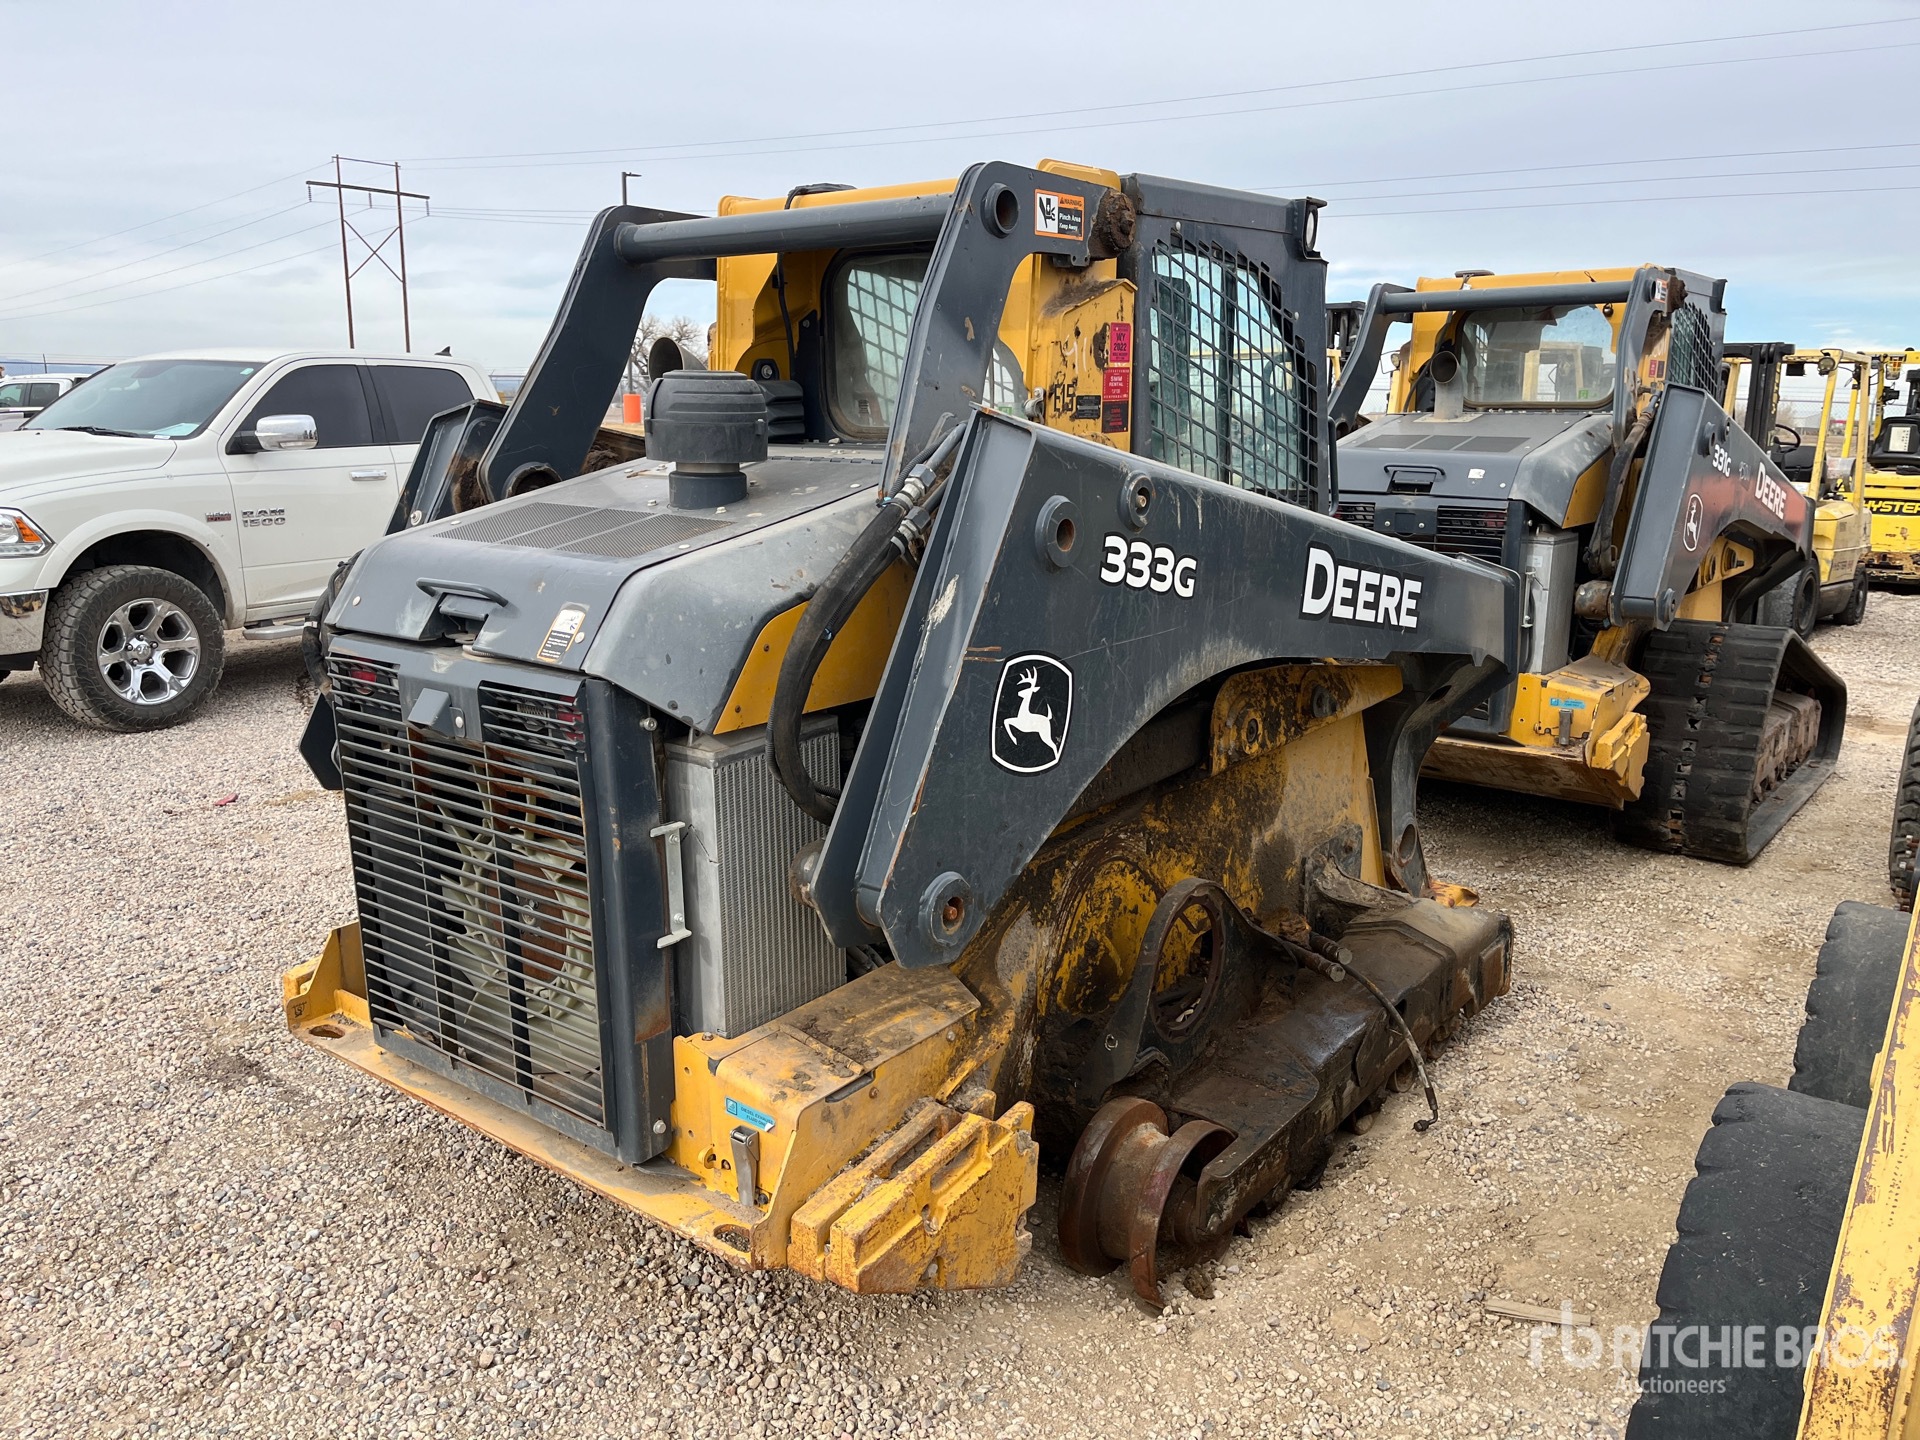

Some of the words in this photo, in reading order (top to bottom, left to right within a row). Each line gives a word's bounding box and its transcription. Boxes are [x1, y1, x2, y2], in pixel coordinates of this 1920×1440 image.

[1754, 461, 1787, 520] DEERE
[242, 508, 285, 518] RAM
[243, 517, 286, 527] 1500
[1100, 535, 1198, 598] 333G
[1302, 547, 1423, 629] DEERE
